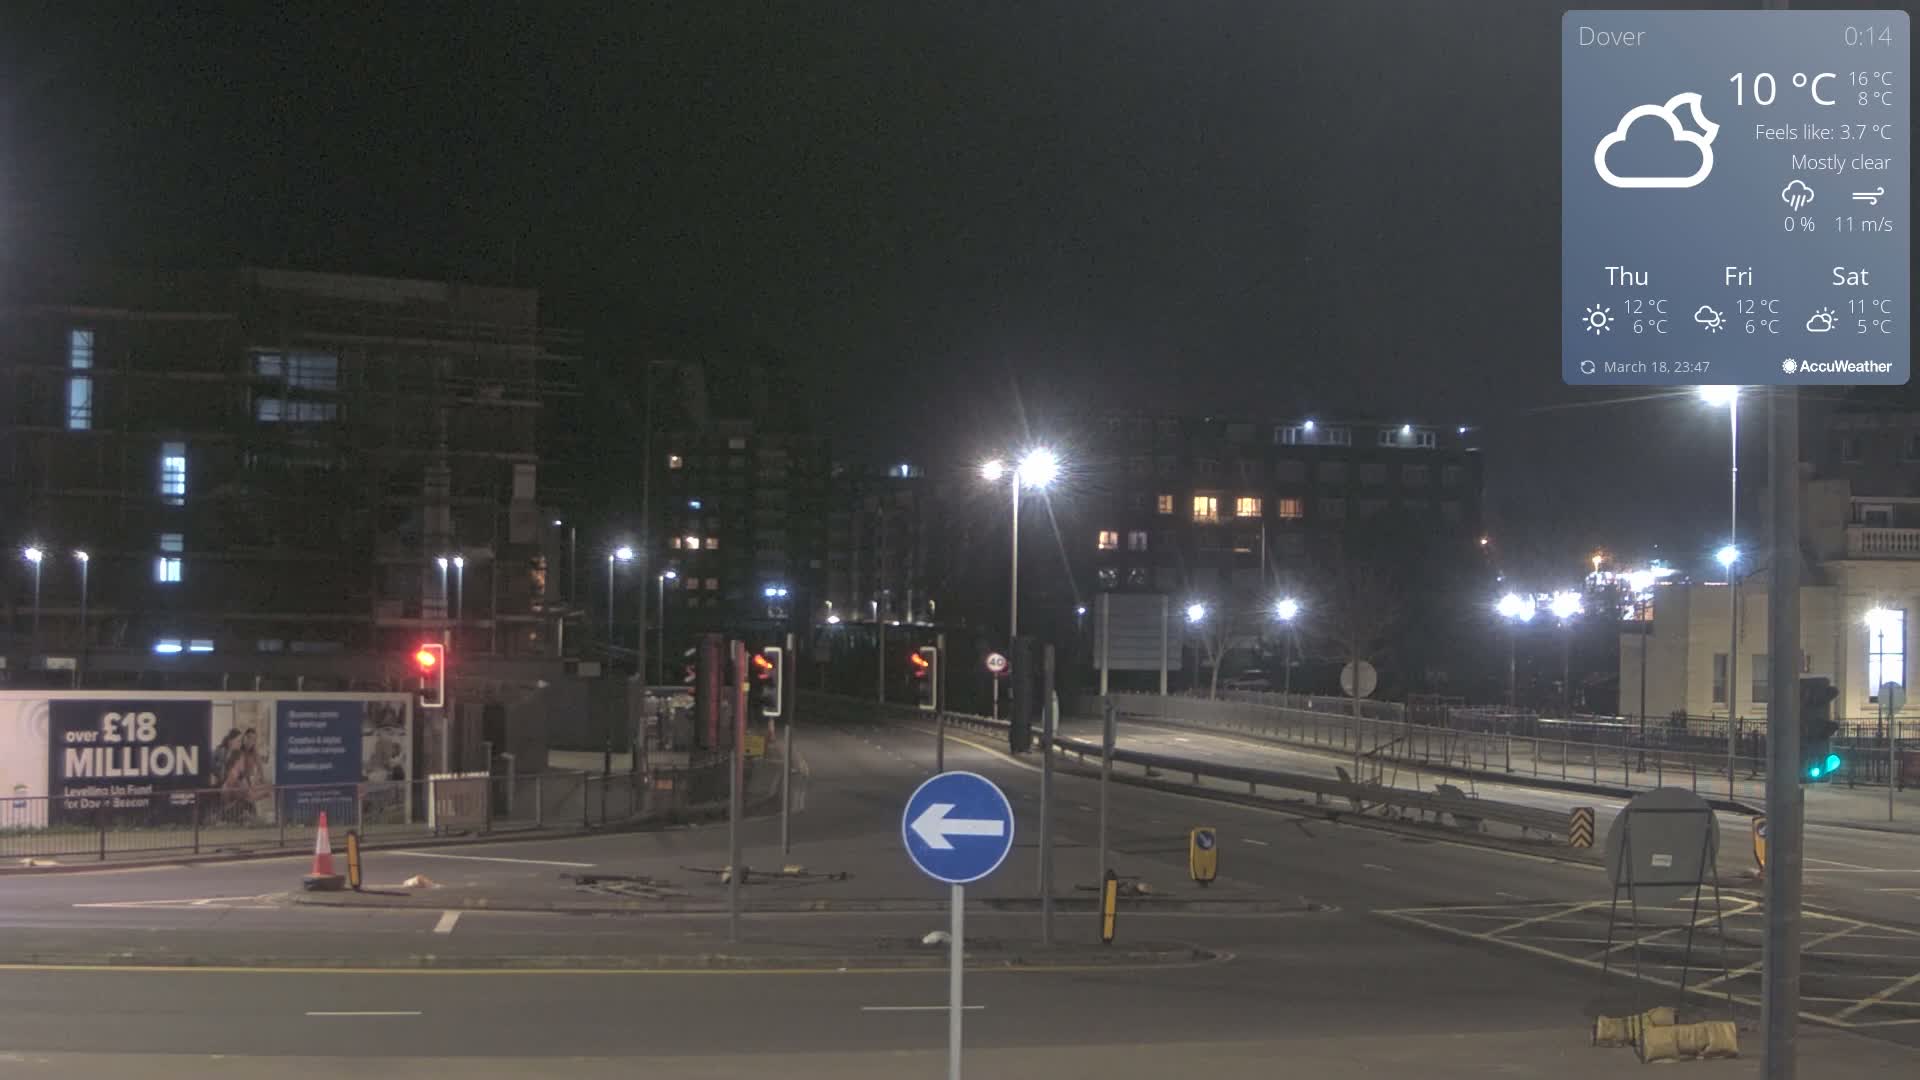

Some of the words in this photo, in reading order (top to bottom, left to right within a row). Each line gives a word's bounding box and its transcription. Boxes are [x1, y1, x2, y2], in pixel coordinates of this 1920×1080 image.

[988, 657, 1005, 667] 40
[65, 731, 98, 742] over
[103, 711, 157, 742] £18
[65, 745, 199, 777] MILLION
[127, 784, 153, 796] Fund
